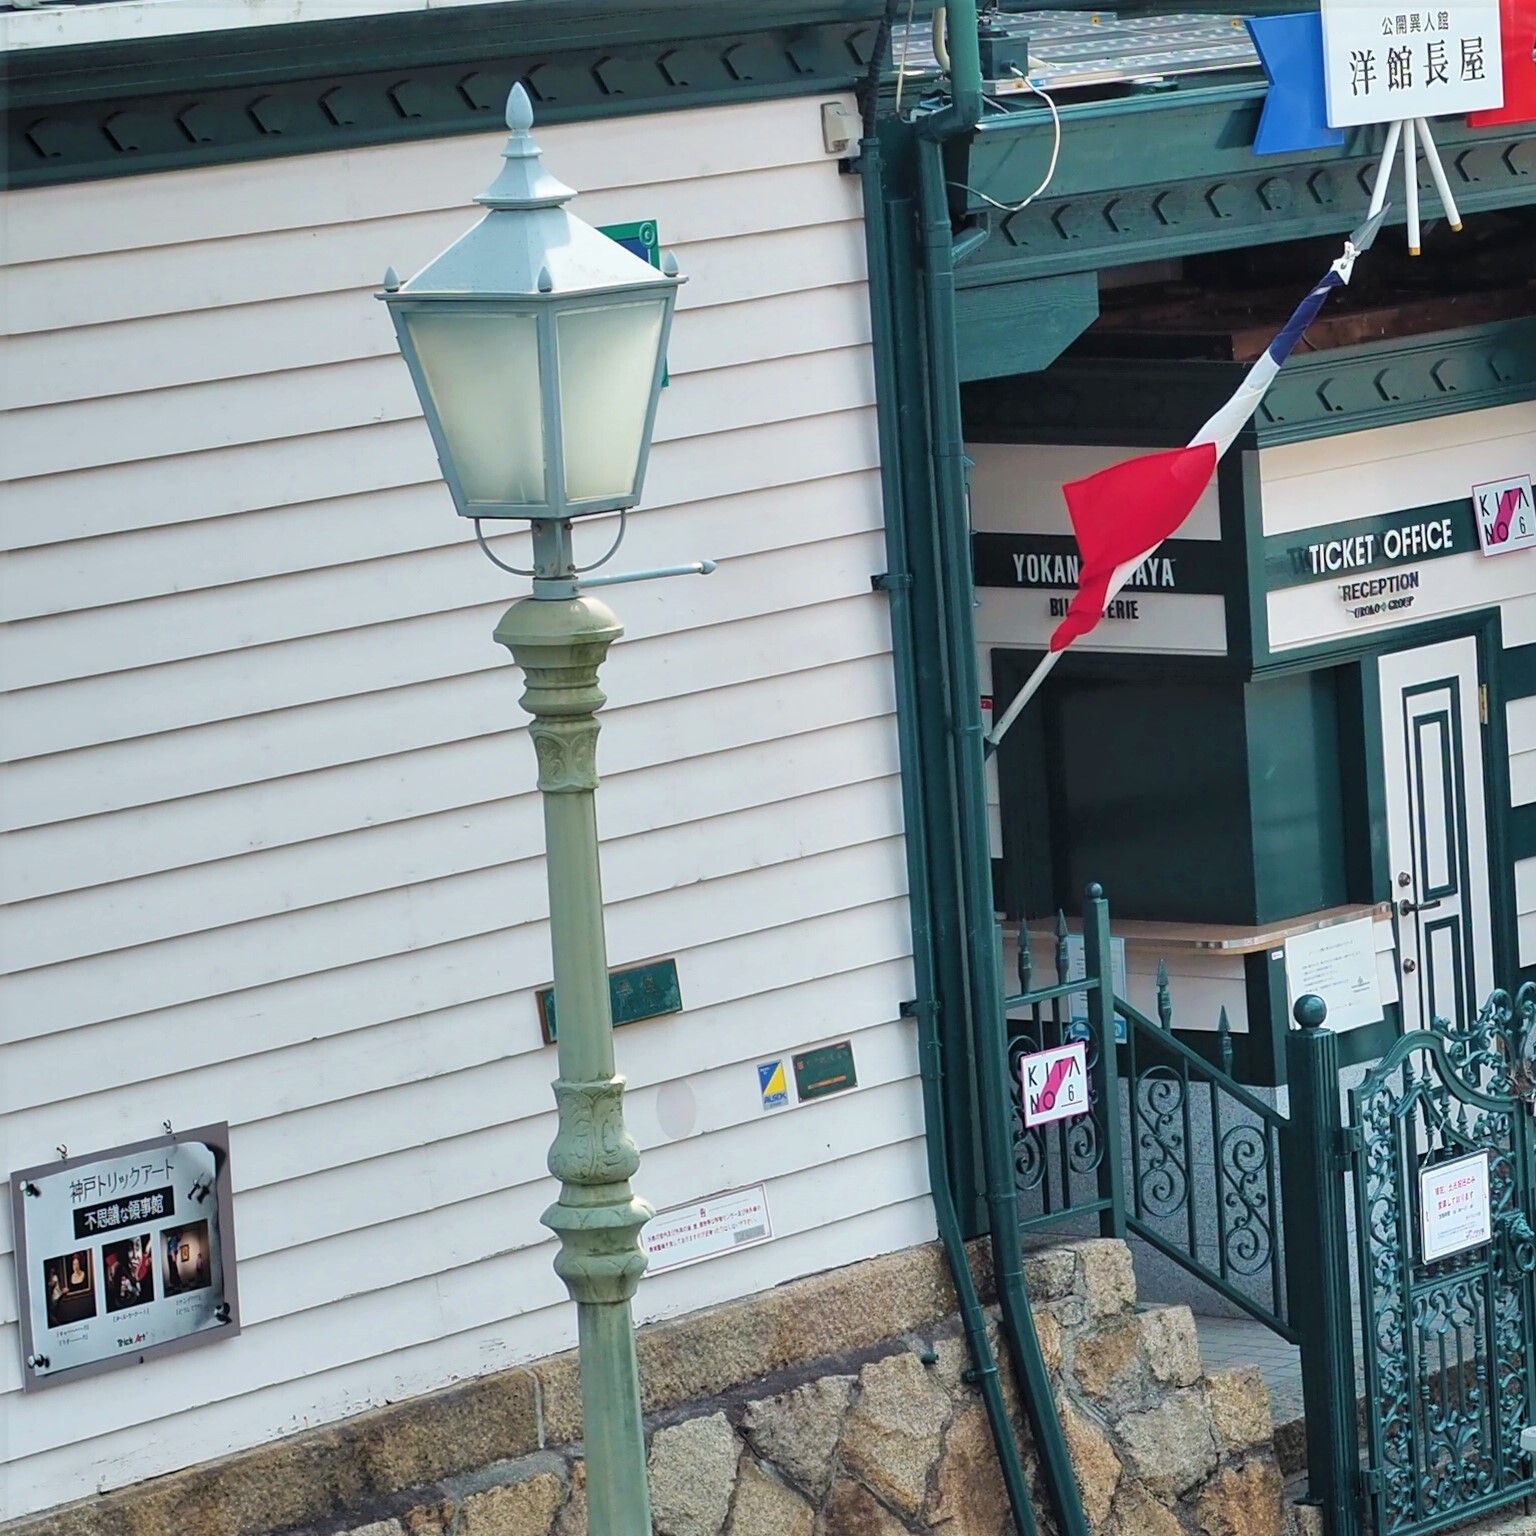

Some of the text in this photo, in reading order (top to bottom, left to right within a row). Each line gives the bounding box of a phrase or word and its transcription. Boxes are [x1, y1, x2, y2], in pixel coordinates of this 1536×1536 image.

[1381, 11, 1450, 36] 公開異人館
[1348, 36, 1486, 97] 洋館長屋
[1517, 515, 1527, 535] 6
[1308, 518, 1453, 575] TICKET OFFICE
[1012, 553, 1079, 584] YOKAN
[1341, 570, 1420, 602] RECEPTION
[1030, 1090, 1056, 1115] NO
[1067, 1083, 1075, 1102] 6
[69, 1158, 175, 1204] 神戸トリックアート
[83, 1193, 164, 1232] 不思議な領事館
